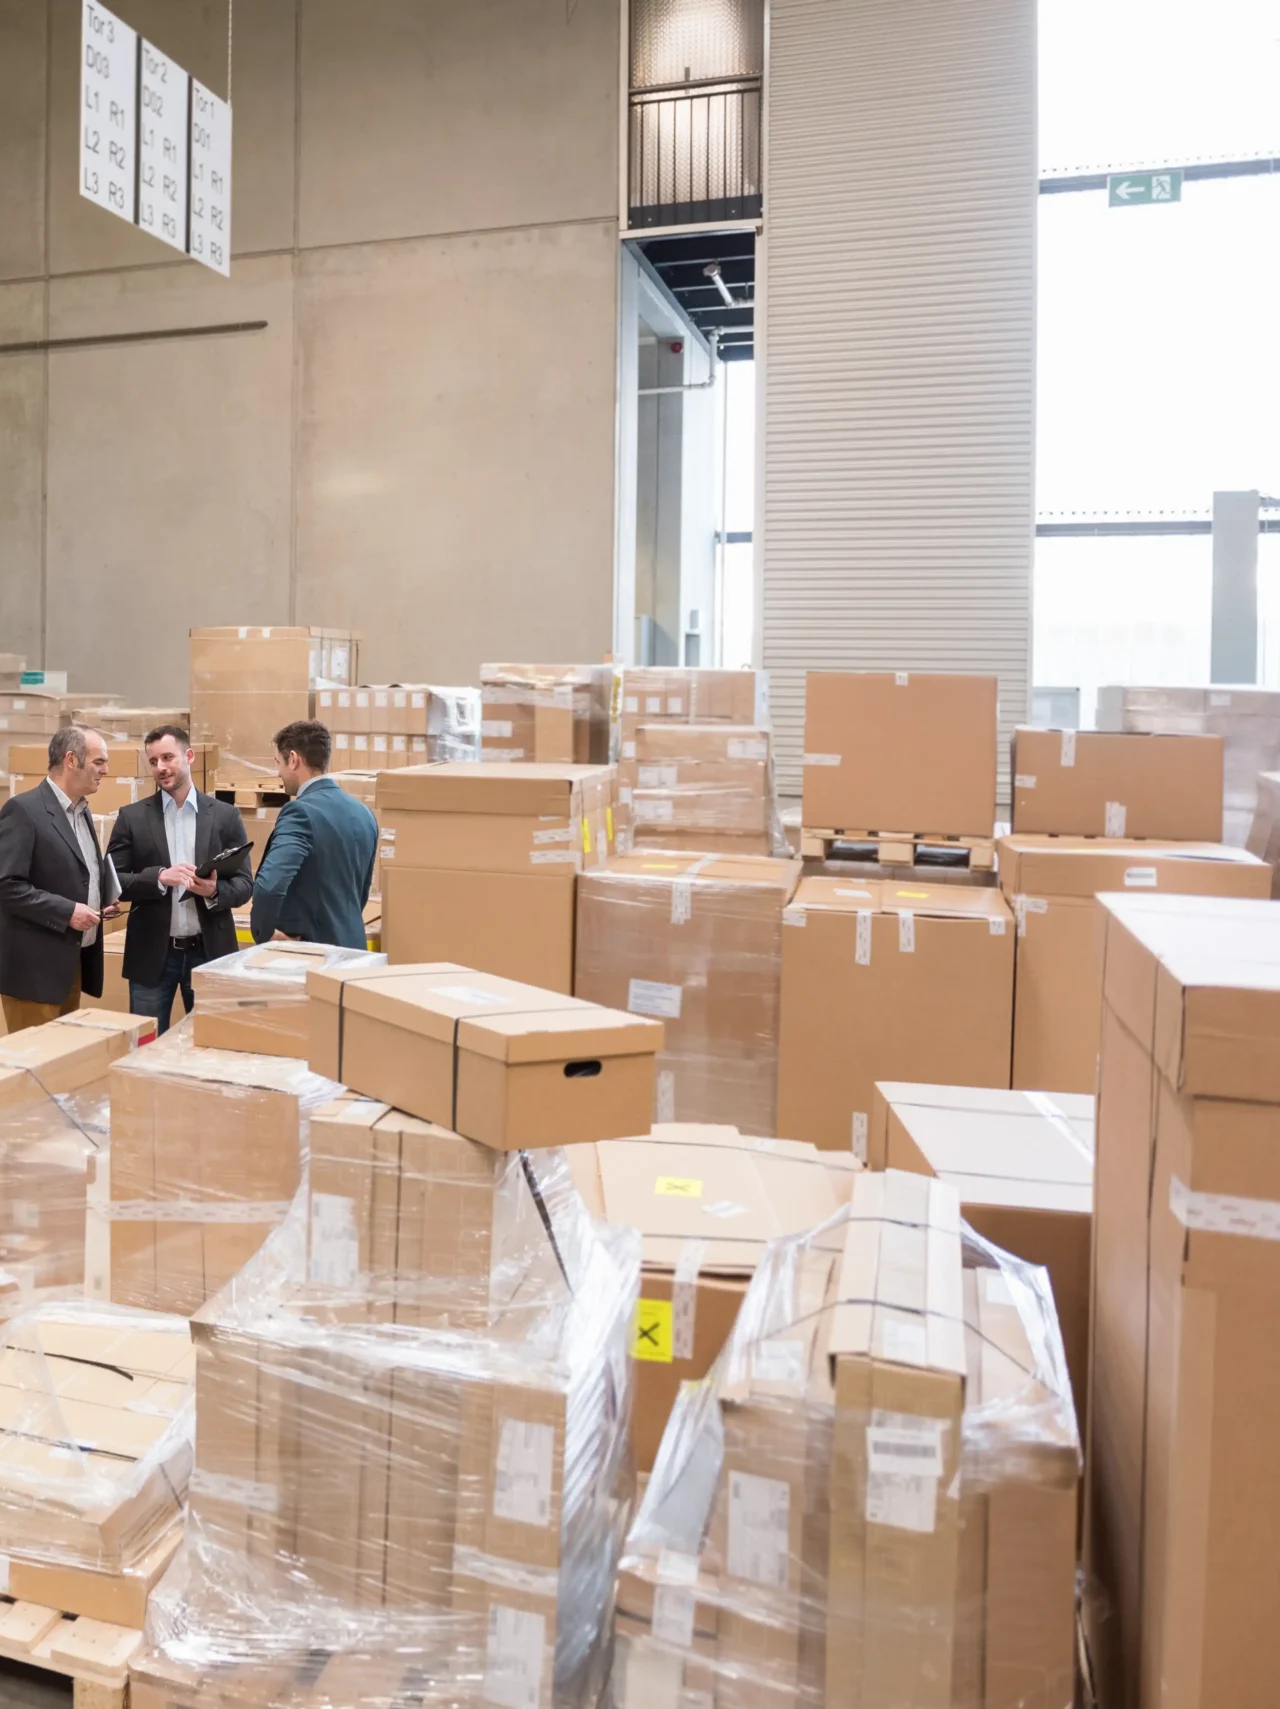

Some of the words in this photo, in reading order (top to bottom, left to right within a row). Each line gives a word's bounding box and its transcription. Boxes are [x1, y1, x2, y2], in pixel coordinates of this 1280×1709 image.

[86, 3, 105, 36] Tor
[106, 19, 115, 44] 3
[85, 43, 110, 80] D03
[143, 46, 158, 76] Tor
[160, 61, 168, 84] 2
[85, 83, 99, 113] L1
[109, 99, 125, 131] R1
[142, 84, 164, 118] D02
[194, 86, 208, 114] Tor
[210, 101, 215, 120] 1
[84, 124, 100, 155] L2
[109, 139, 126, 170] R2
[142, 121, 154, 150] L1
[163, 136, 177, 164] R1
[193, 121, 211, 152] D01
[84, 165, 99, 195] L3
[108, 180, 125, 210] R3
[142, 161, 155, 189] L2
[163, 174, 177, 203] R2
[192, 157, 204, 183] L1
[210, 169, 223, 195] R1
[141, 200, 154, 227] L3
[162, 212, 177, 240] R3
[192, 192, 205, 219] L2
[210, 204, 224, 232] R2
[192, 228, 204, 255] L3
[210, 241, 223, 266] R3
